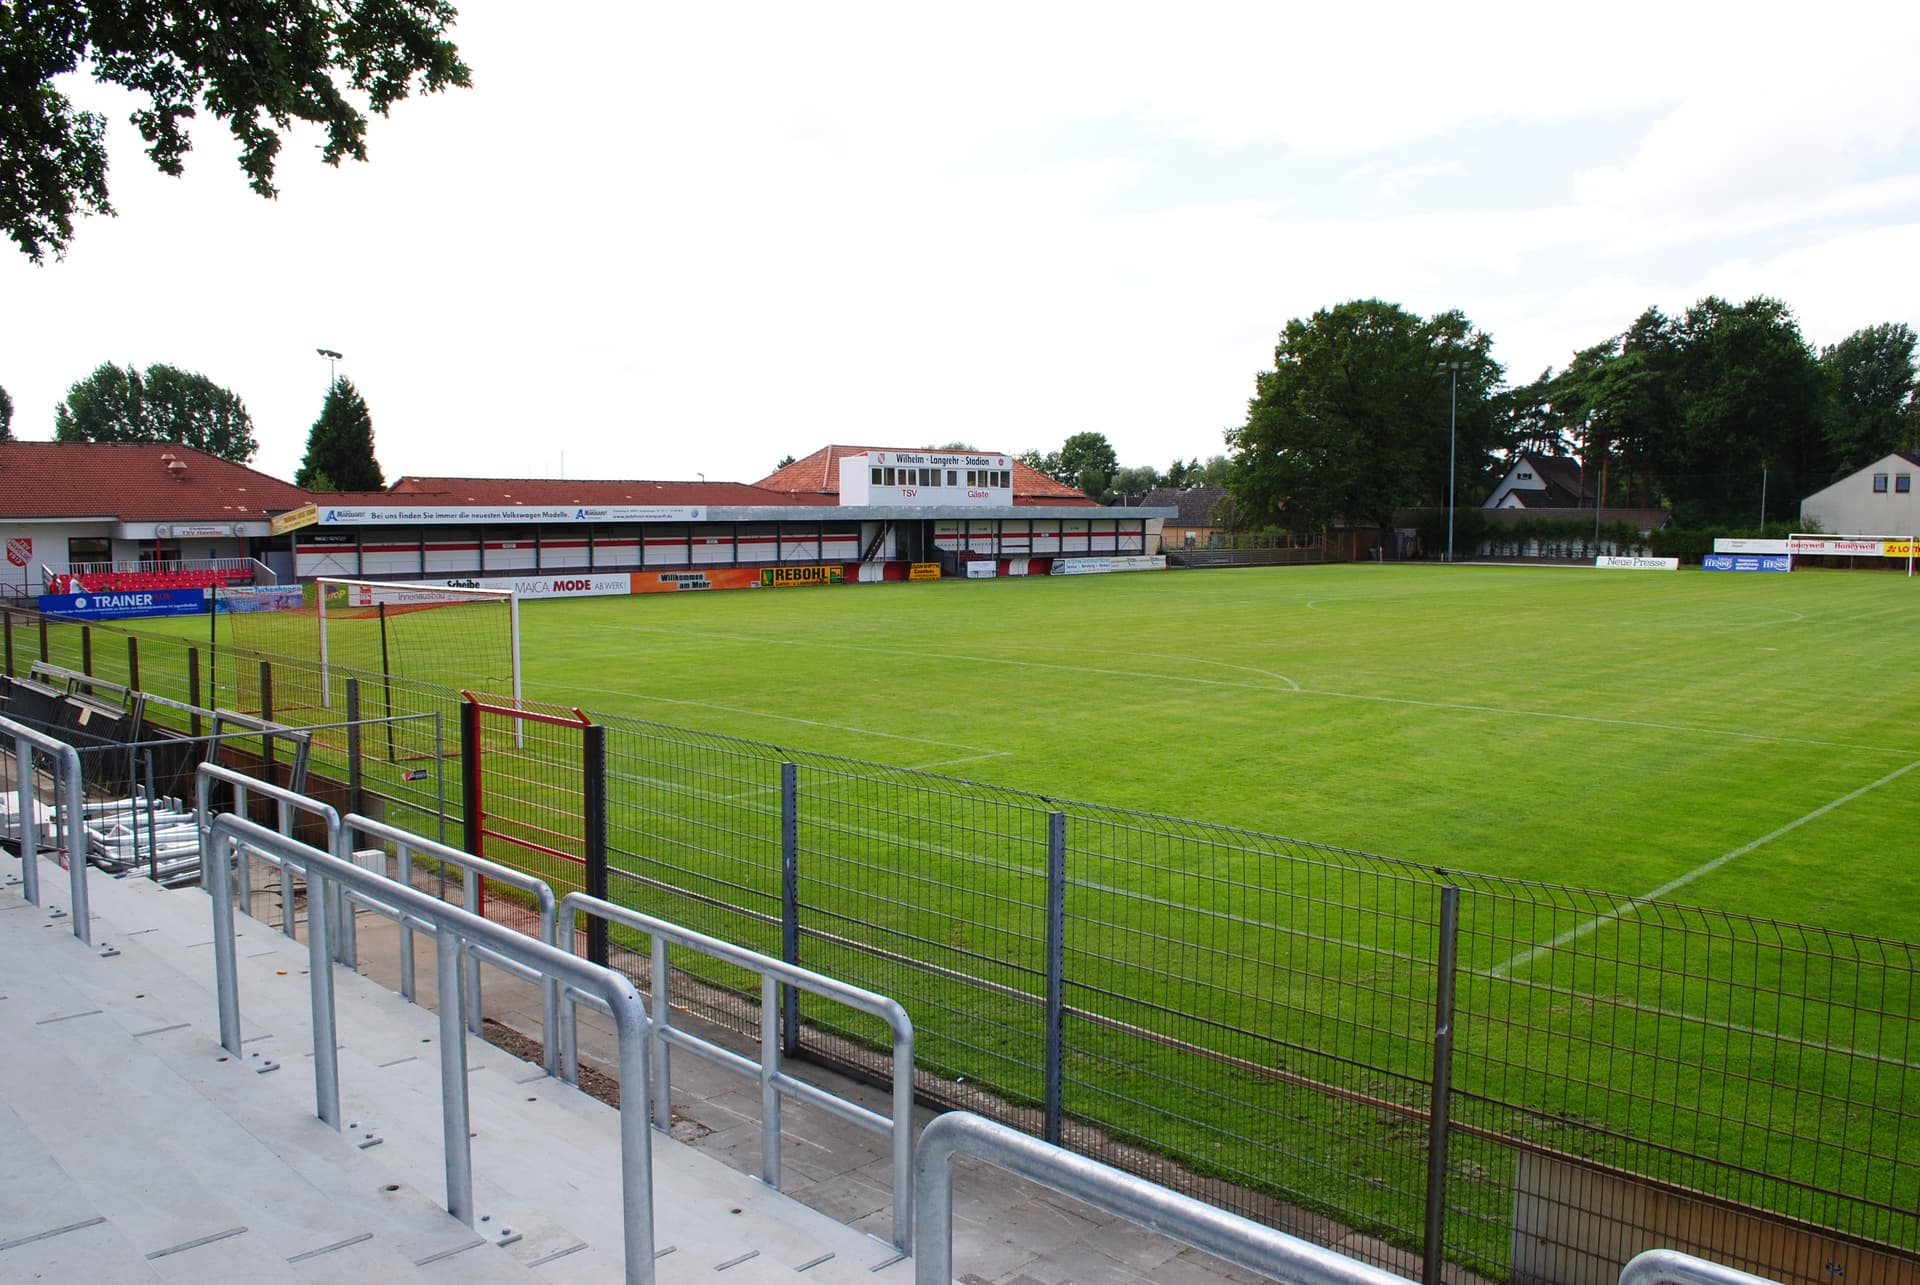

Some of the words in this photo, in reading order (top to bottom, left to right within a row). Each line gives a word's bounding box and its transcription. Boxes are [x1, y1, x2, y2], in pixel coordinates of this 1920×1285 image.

[896, 454, 924, 464] Wilhelm
[930, 455, 959, 466] Langrehr
[965, 457, 990, 466] Stadion
[902, 489, 917, 497] TSV
[371, 511, 383, 519] Bei
[399, 511, 421, 519] finden
[422, 511, 434, 519] Sie
[435, 511, 457, 519] immer
[458, 511, 469, 519] die
[502, 511, 541, 519] Volkswagen
[1834, 541, 1876, 551] Honeywell
[1608, 557, 1632, 566] Neue
[1633, 558, 1666, 567] Presse
[660, 573, 704, 582] Willkommen
[775, 567, 829, 581] REBOHL
[446, 579, 481, 589] Scheibe
[515, 581, 550, 593] MAICA
[553, 579, 592, 592] MODE
[92, 593, 153, 608] TRAINER
